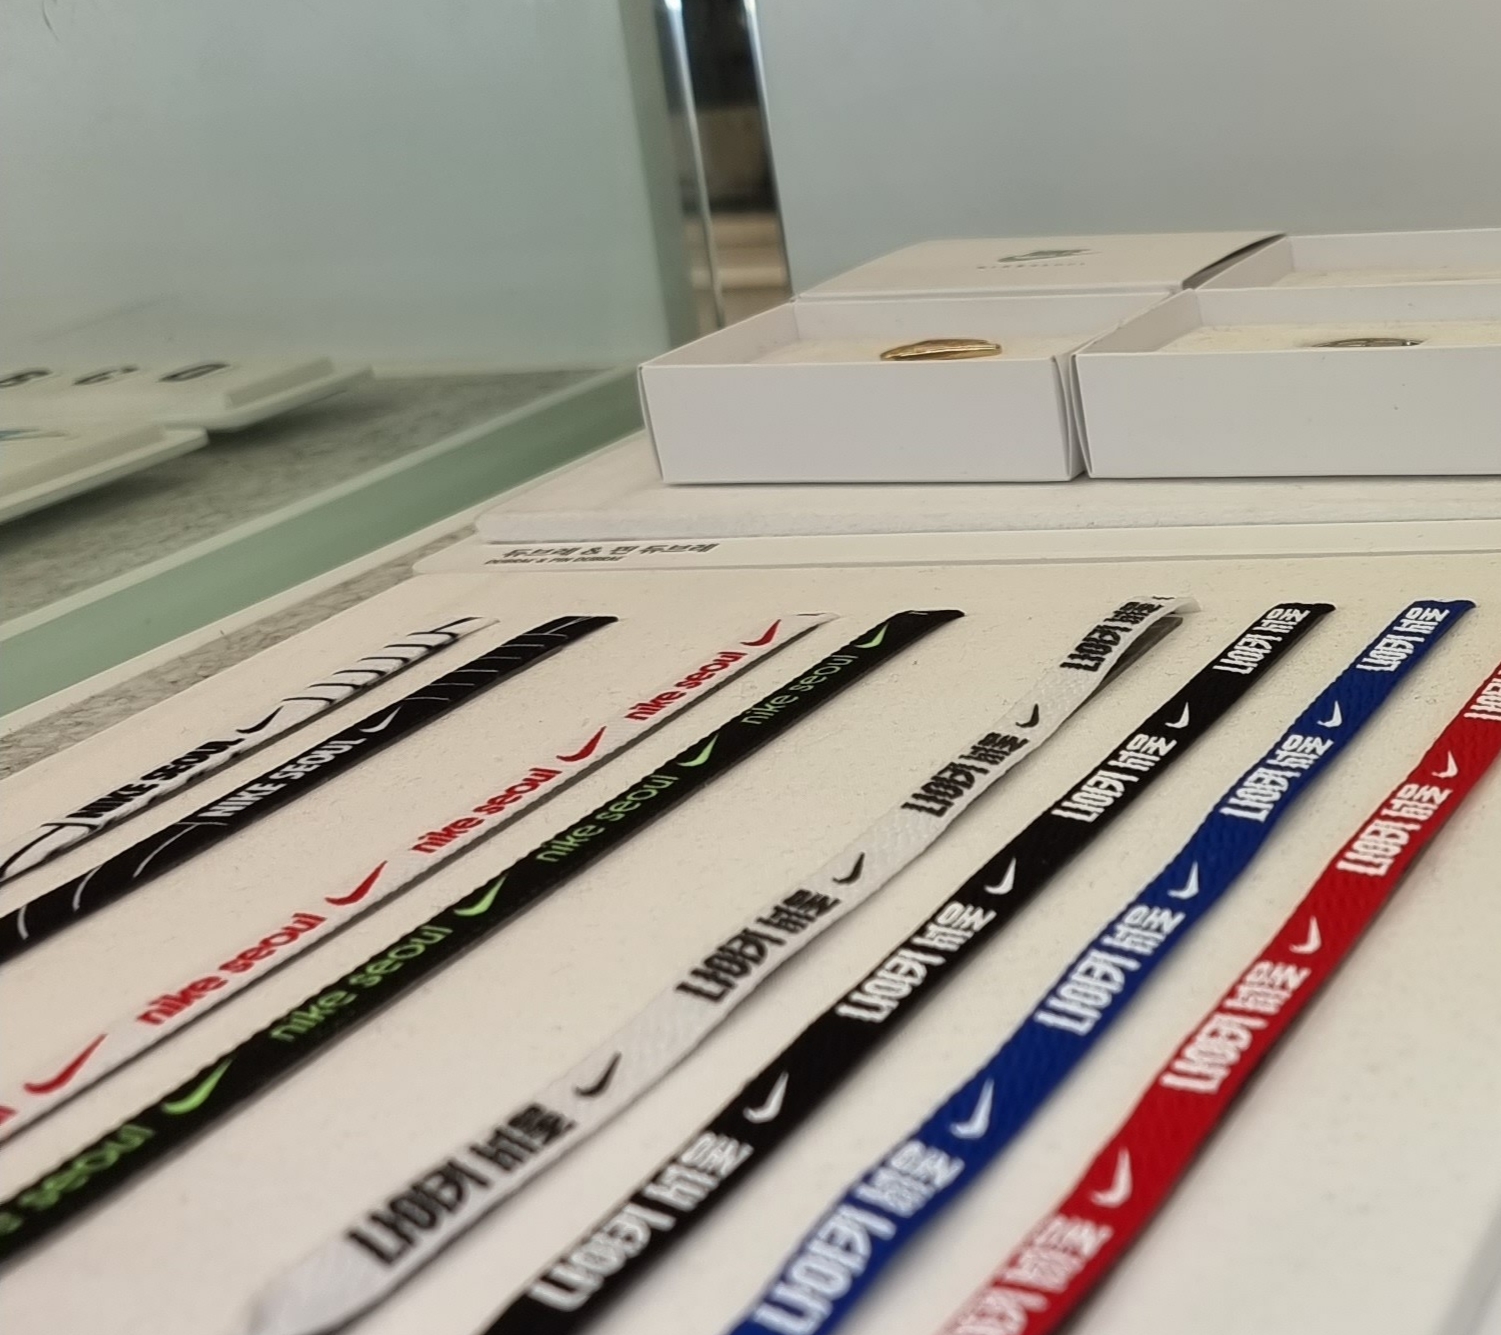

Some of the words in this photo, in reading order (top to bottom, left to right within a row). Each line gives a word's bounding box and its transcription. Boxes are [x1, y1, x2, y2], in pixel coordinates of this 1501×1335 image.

[625, 689, 686, 721] nike
[674, 651, 748, 690] seoul
[740, 695, 799, 726] nike
[789, 654, 858, 693] seoul
[66, 783, 158, 819] NIKE
[141, 738, 245, 782] SEOUL
[198, 782, 287, 817] NIKE
[274, 738, 366, 780] SEOUL
[412, 816, 485, 853] nike
[473, 767, 563, 815] seoul
[536, 824, 605, 862] nike
[596, 774, 680, 822] seoul
[137, 976, 228, 1026] nike
[219, 912, 327, 974] seoul
[270, 990, 357, 1043] nike
[350, 925, 453, 989] seoul
